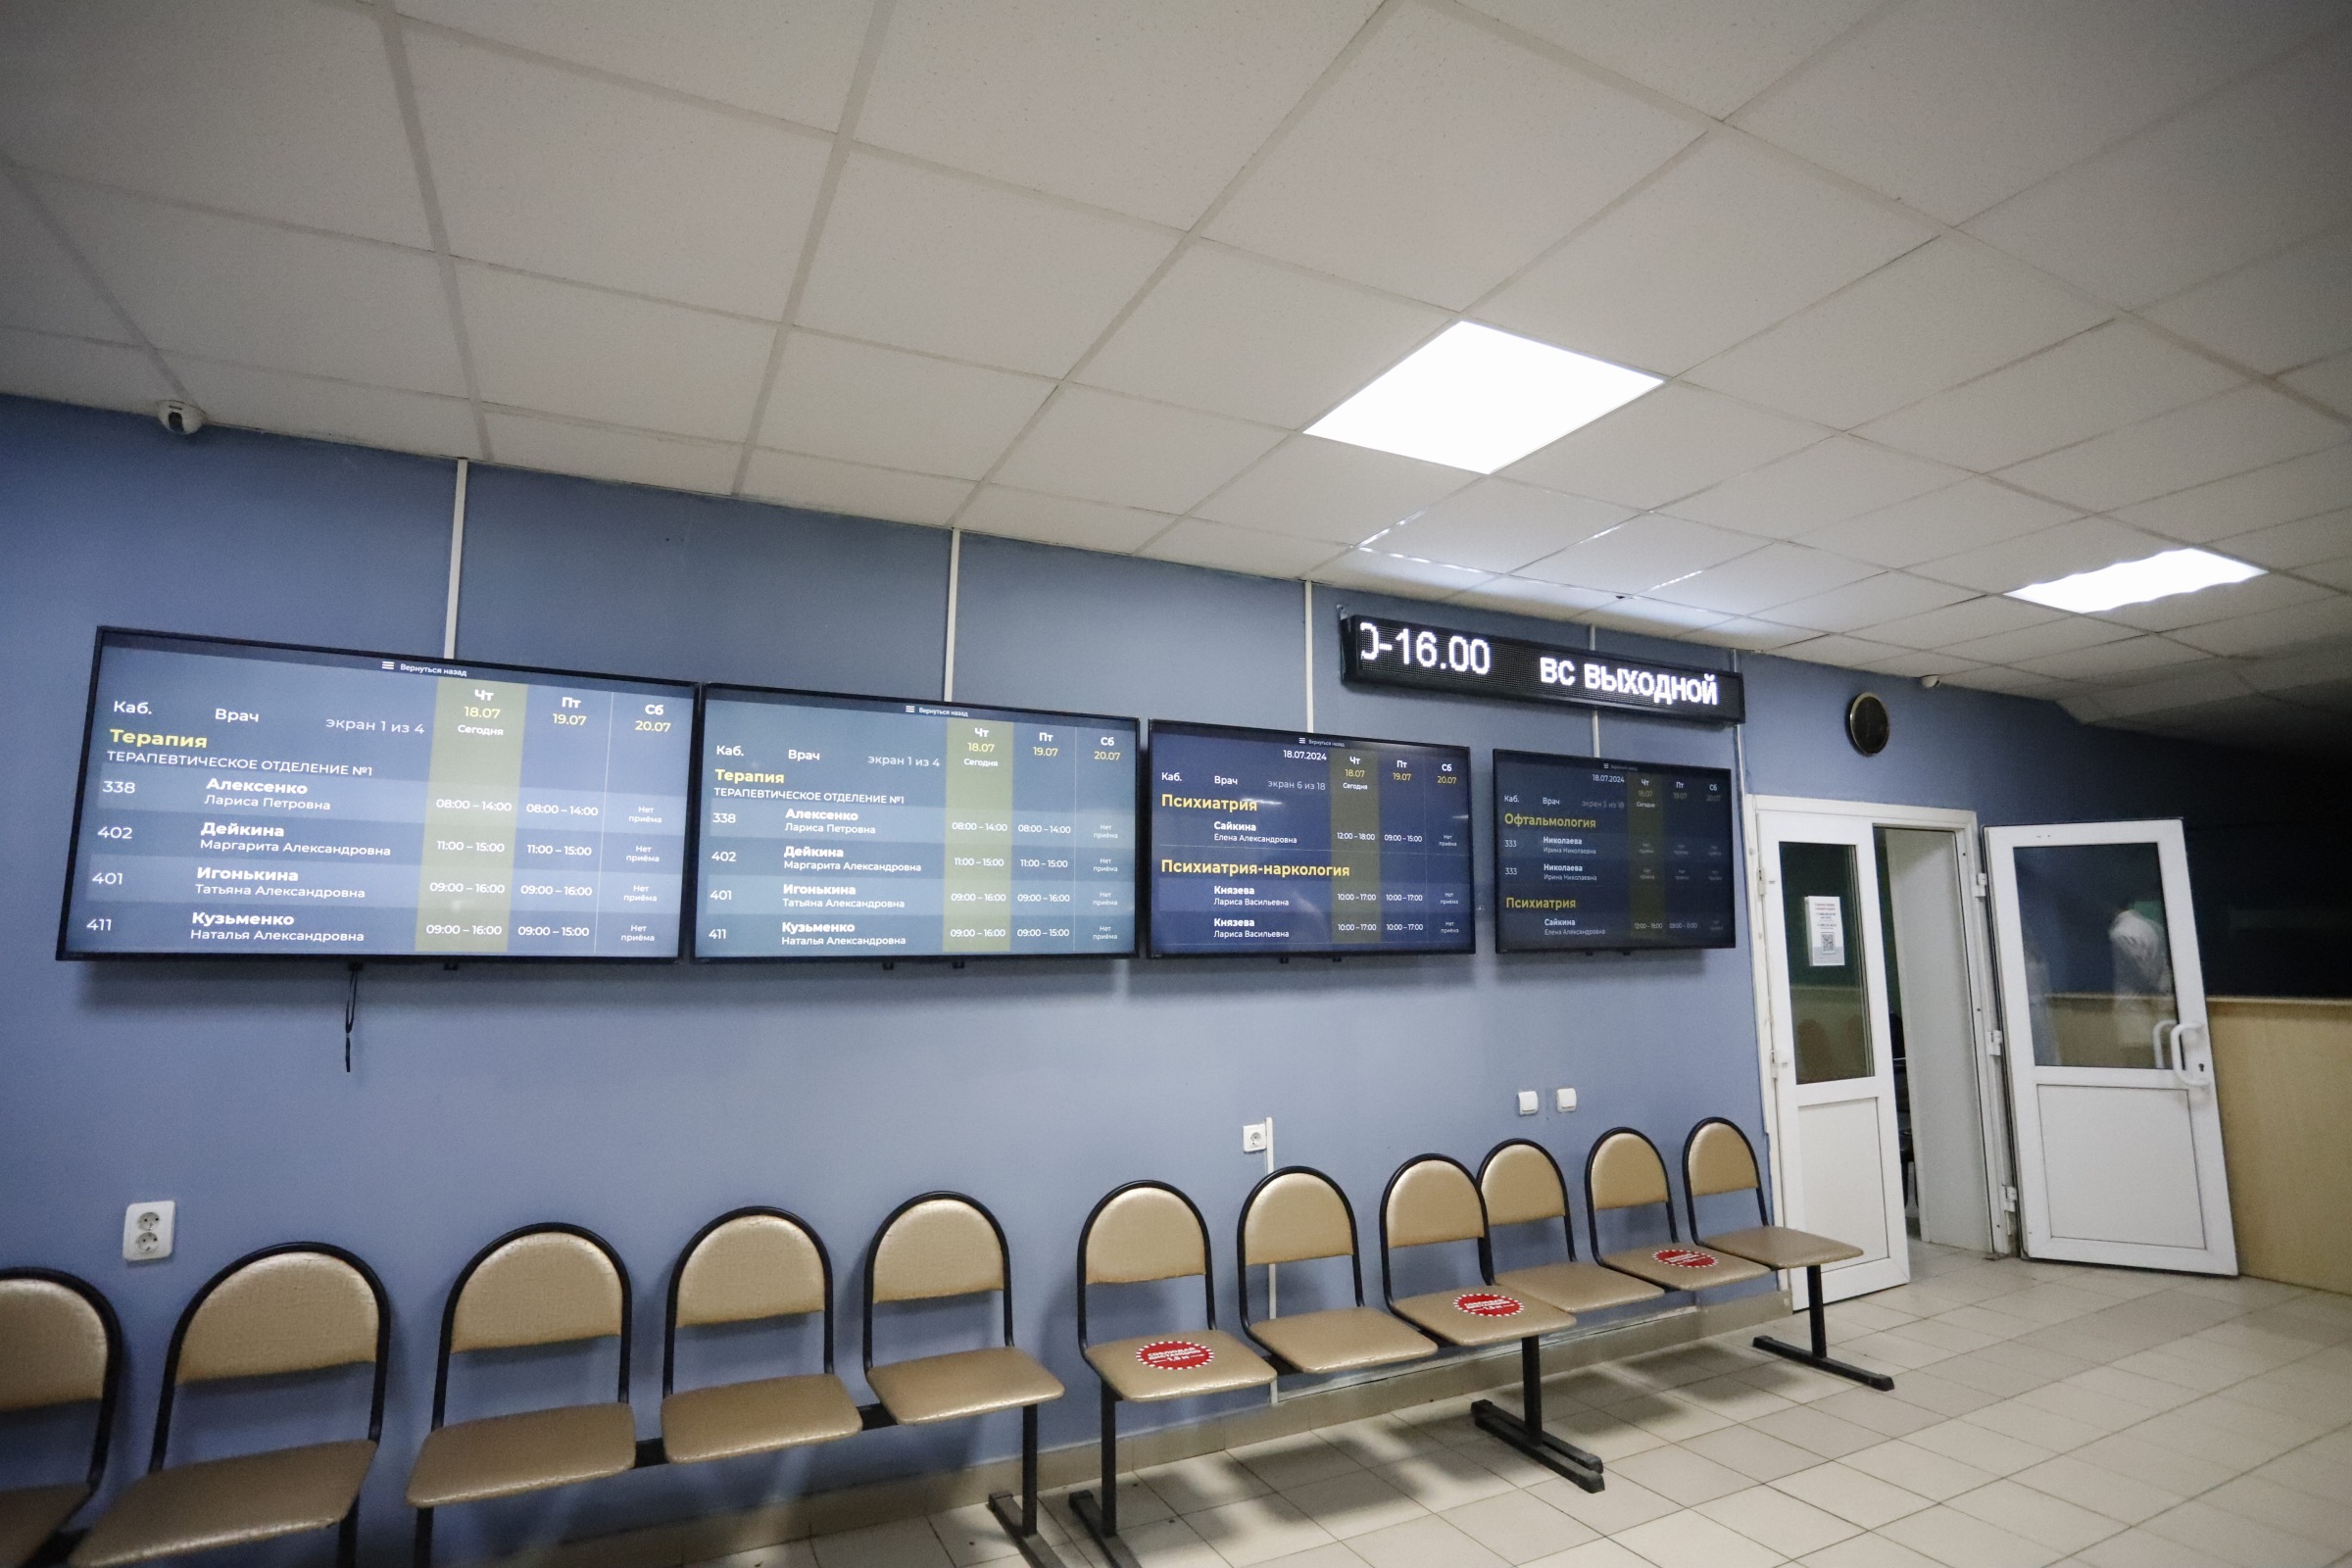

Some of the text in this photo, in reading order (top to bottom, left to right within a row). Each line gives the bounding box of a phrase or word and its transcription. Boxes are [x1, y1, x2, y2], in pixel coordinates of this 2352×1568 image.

[400, 663, 466, 677] Вернуться назад
[1540, 657, 1718, 706] ВС ВЫХОДНОЙ
[474, 690, 494, 701] Чт
[114, 701, 152, 714] Каб.
[562, 697, 581, 709] Пт
[215, 710, 259, 722] Врач
[465, 707, 501, 719] 18.07
[645, 705, 663, 715] Сб
[919, 708, 950, 716] Вернуться
[325, 718, 424, 733] экран 1 из 4
[553, 713, 586, 726] 19.07
[458, 725, 504, 736] Сегодня
[635, 720, 670, 733] 20.07
[974, 728, 989, 737] Чт
[110, 728, 208, 748] Терапия
[1039, 733, 1053, 742] Пт
[1101, 737, 1114, 746] Сб
[716, 746, 744, 757] Каб.
[967, 742, 995, 754] 18.07
[1033, 747, 1057, 757] 19.07
[788, 750, 819, 761] Врач
[1094, 751, 1120, 760] 20.07
[1284, 750, 1327, 760] 18.07.2024
[1349, 757, 1360, 765] Чт
[107, 751, 257, 769] ТЕРАПЕВТИЧЕСКОЕ
[261, 760, 349, 775] ОТДЕЛЕНИЕ
[868, 756, 905, 766] экран
[932, 759, 940, 767] 4
[964, 759, 998, 767] Сегодня
[715, 768, 784, 784] Терапия
[1161, 772, 1182, 782] Каб.
[1214, 776, 1238, 785] Врач
[1393, 772, 1411, 781] 19.07
[1592, 774, 1625, 783] 18.07.2024
[102, 781, 135, 793] 338
[206, 778, 308, 795] Алексенко
[1267, 780, 1295, 790] экран
[1317, 782, 1325, 791] 18
[714, 787, 821, 802] ТЕРАПЕВТИЧЕСКОЕ
[823, 793, 887, 805] ОТДЕЛЕНИЕ
[204, 795, 330, 810] Лариса Петровна
[436, 799, 512, 811] 08:00 14:00
[1161, 794, 1257, 813] Психиатрия
[526, 804, 598, 815] 08:00 14:00
[786, 808, 858, 821] Алексенко
[712, 813, 736, 823] 338
[1504, 813, 1596, 828] Офтальмология
[98, 826, 132, 839] 402
[201, 822, 284, 837] Дейкина
[785, 823, 876, 835] Лариса Петровна
[1214, 821, 1256, 832] Сайкина
[1240, 835, 1297, 844] Александровна
[200, 840, 391, 857] Маргарита Александровна
[436, 841, 505, 853] 11:00 15:00
[527, 844, 592, 856] 11:00 15:00
[784, 846, 844, 858] Дейкина
[711, 852, 736, 861] 402
[784, 860, 921, 873] Маргарита Александровна
[1161, 858, 1350, 878] Психиатрия-наркология
[92, 872, 123, 884] 401
[197, 866, 298, 881] Игонькина
[195, 884, 366, 899] Татьяна Александровна
[429, 882, 505, 894] 09:00 16:00
[520, 885, 592, 896] 09:00 16:00
[783, 884, 856, 896] Игонькина
[1214, 886, 1254, 895] Князева
[710, 890, 732, 900] 401
[783, 899, 905, 909] Татьяна Александровна
[1506, 898, 1576, 910] Психиатрия
[86, 918, 112, 930] 411
[192, 912, 294, 926] Кузьменко
[1214, 918, 1254, 927] Князева
[426, 924, 502, 935] 09:00 16:00
[517, 926, 589, 937] 09:00 15:00
[782, 922, 855, 933] Кузьменко
[190, 930, 364, 943] Наталья Александровна
[709, 929, 726, 939] 411
[826, 937, 906, 947] Александровна
